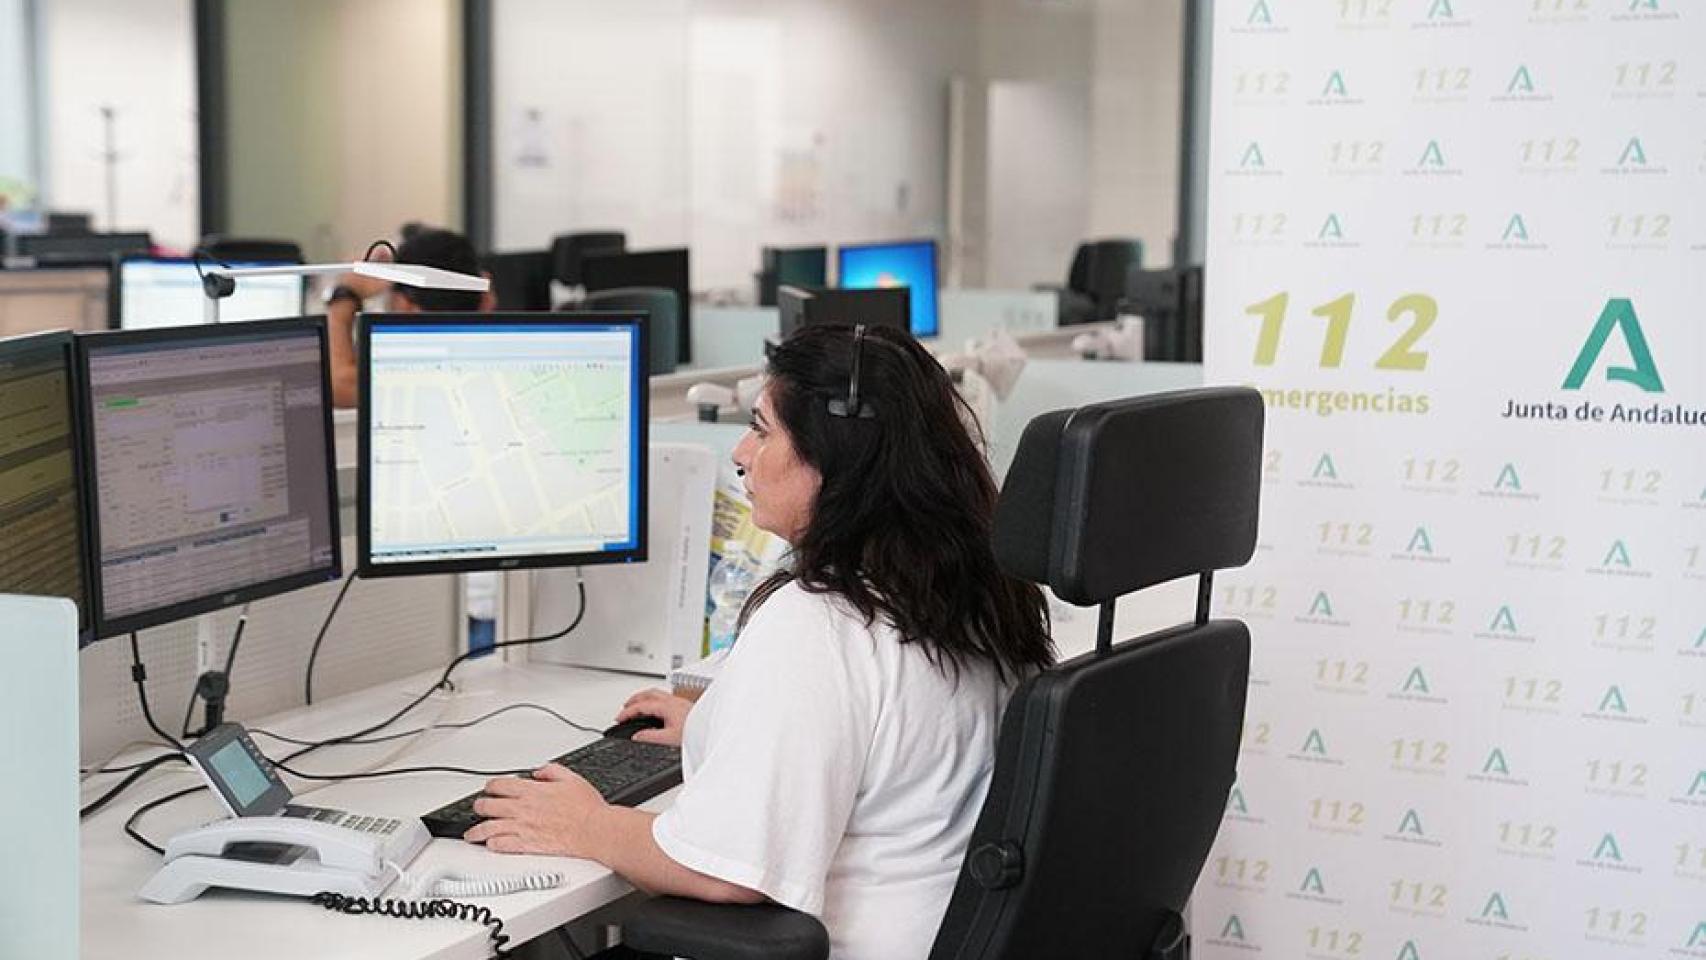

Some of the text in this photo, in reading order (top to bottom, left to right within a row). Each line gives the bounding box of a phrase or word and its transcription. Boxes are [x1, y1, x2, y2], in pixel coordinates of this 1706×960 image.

[1236, 71, 1291, 94] 112
[1415, 68, 1470, 89] 112
[1615, 61, 1677, 85] 112
[1330, 142, 1385, 163] 112
[1521, 138, 1579, 162] 112
[1234, 213, 1286, 235] 112
[1412, 213, 1467, 236] 112
[1609, 215, 1670, 237] 112
[1245, 292, 1438, 371] 112
[1248, 384, 1430, 416] mergencias
[1501, 400, 1568, 420] Junta
[1575, 401, 1604, 421] de
[1403, 458, 1461, 481] 112
[1600, 468, 1662, 493] 112
[1319, 522, 1373, 545] 112
[1507, 534, 1566, 560] 112
[1222, 586, 1277, 608] 112
[1400, 598, 1455, 623] 112
[1595, 613, 1656, 639] 112
[1315, 659, 1368, 682] 112
[1505, 676, 1562, 701] 112
[1392, 738, 1448, 764] 112
[1588, 760, 1648, 786] 112
[1308, 799, 1364, 824] 112
[1500, 823, 1557, 848] 112
[1215, 857, 1269, 881] 112
[1390, 879, 1447, 907] 112
[1586, 907, 1648, 936] 112
[1307, 927, 1362, 953] 112
